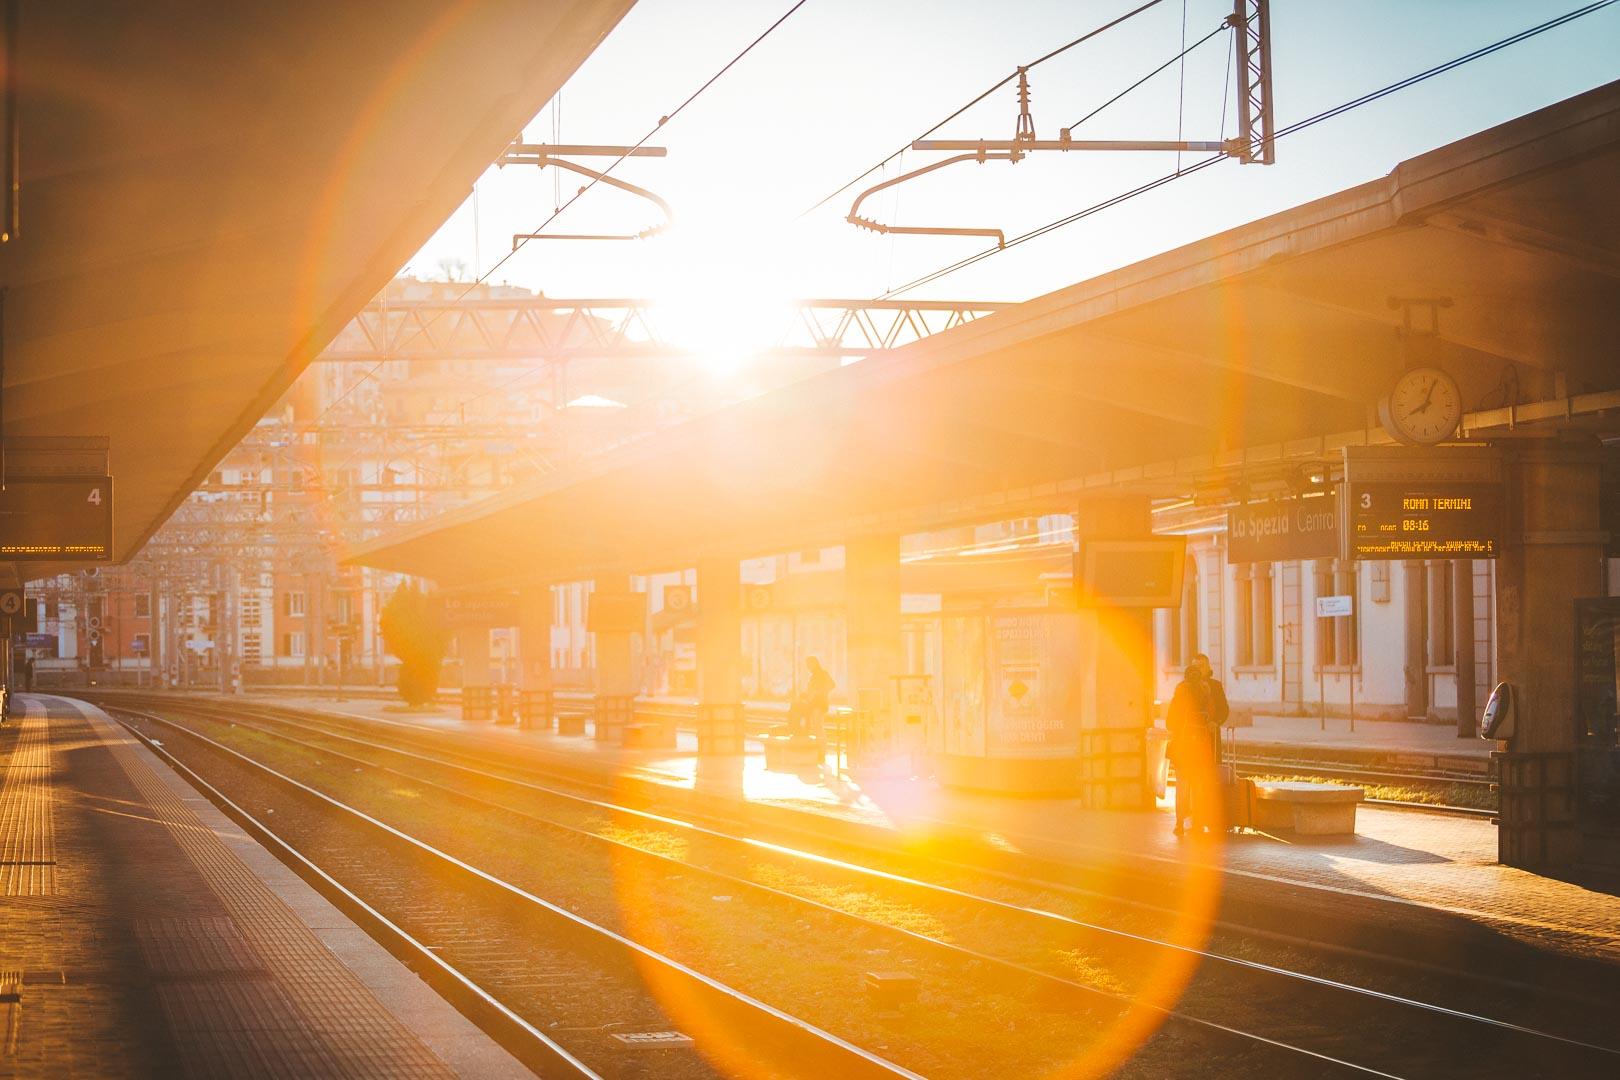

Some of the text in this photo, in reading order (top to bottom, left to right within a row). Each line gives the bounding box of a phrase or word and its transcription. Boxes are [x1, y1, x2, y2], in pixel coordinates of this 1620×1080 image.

[87, 488, 101, 505] 4
[1360, 493, 1372, 510] 3
[1432, 498, 1472, 510] TERMINI
[1232, 513, 1246, 538] La
[1249, 507, 1289, 543] Spezia
[1402, 519, 1429, 531] 08:16
[5, 597, 16, 609] 4
